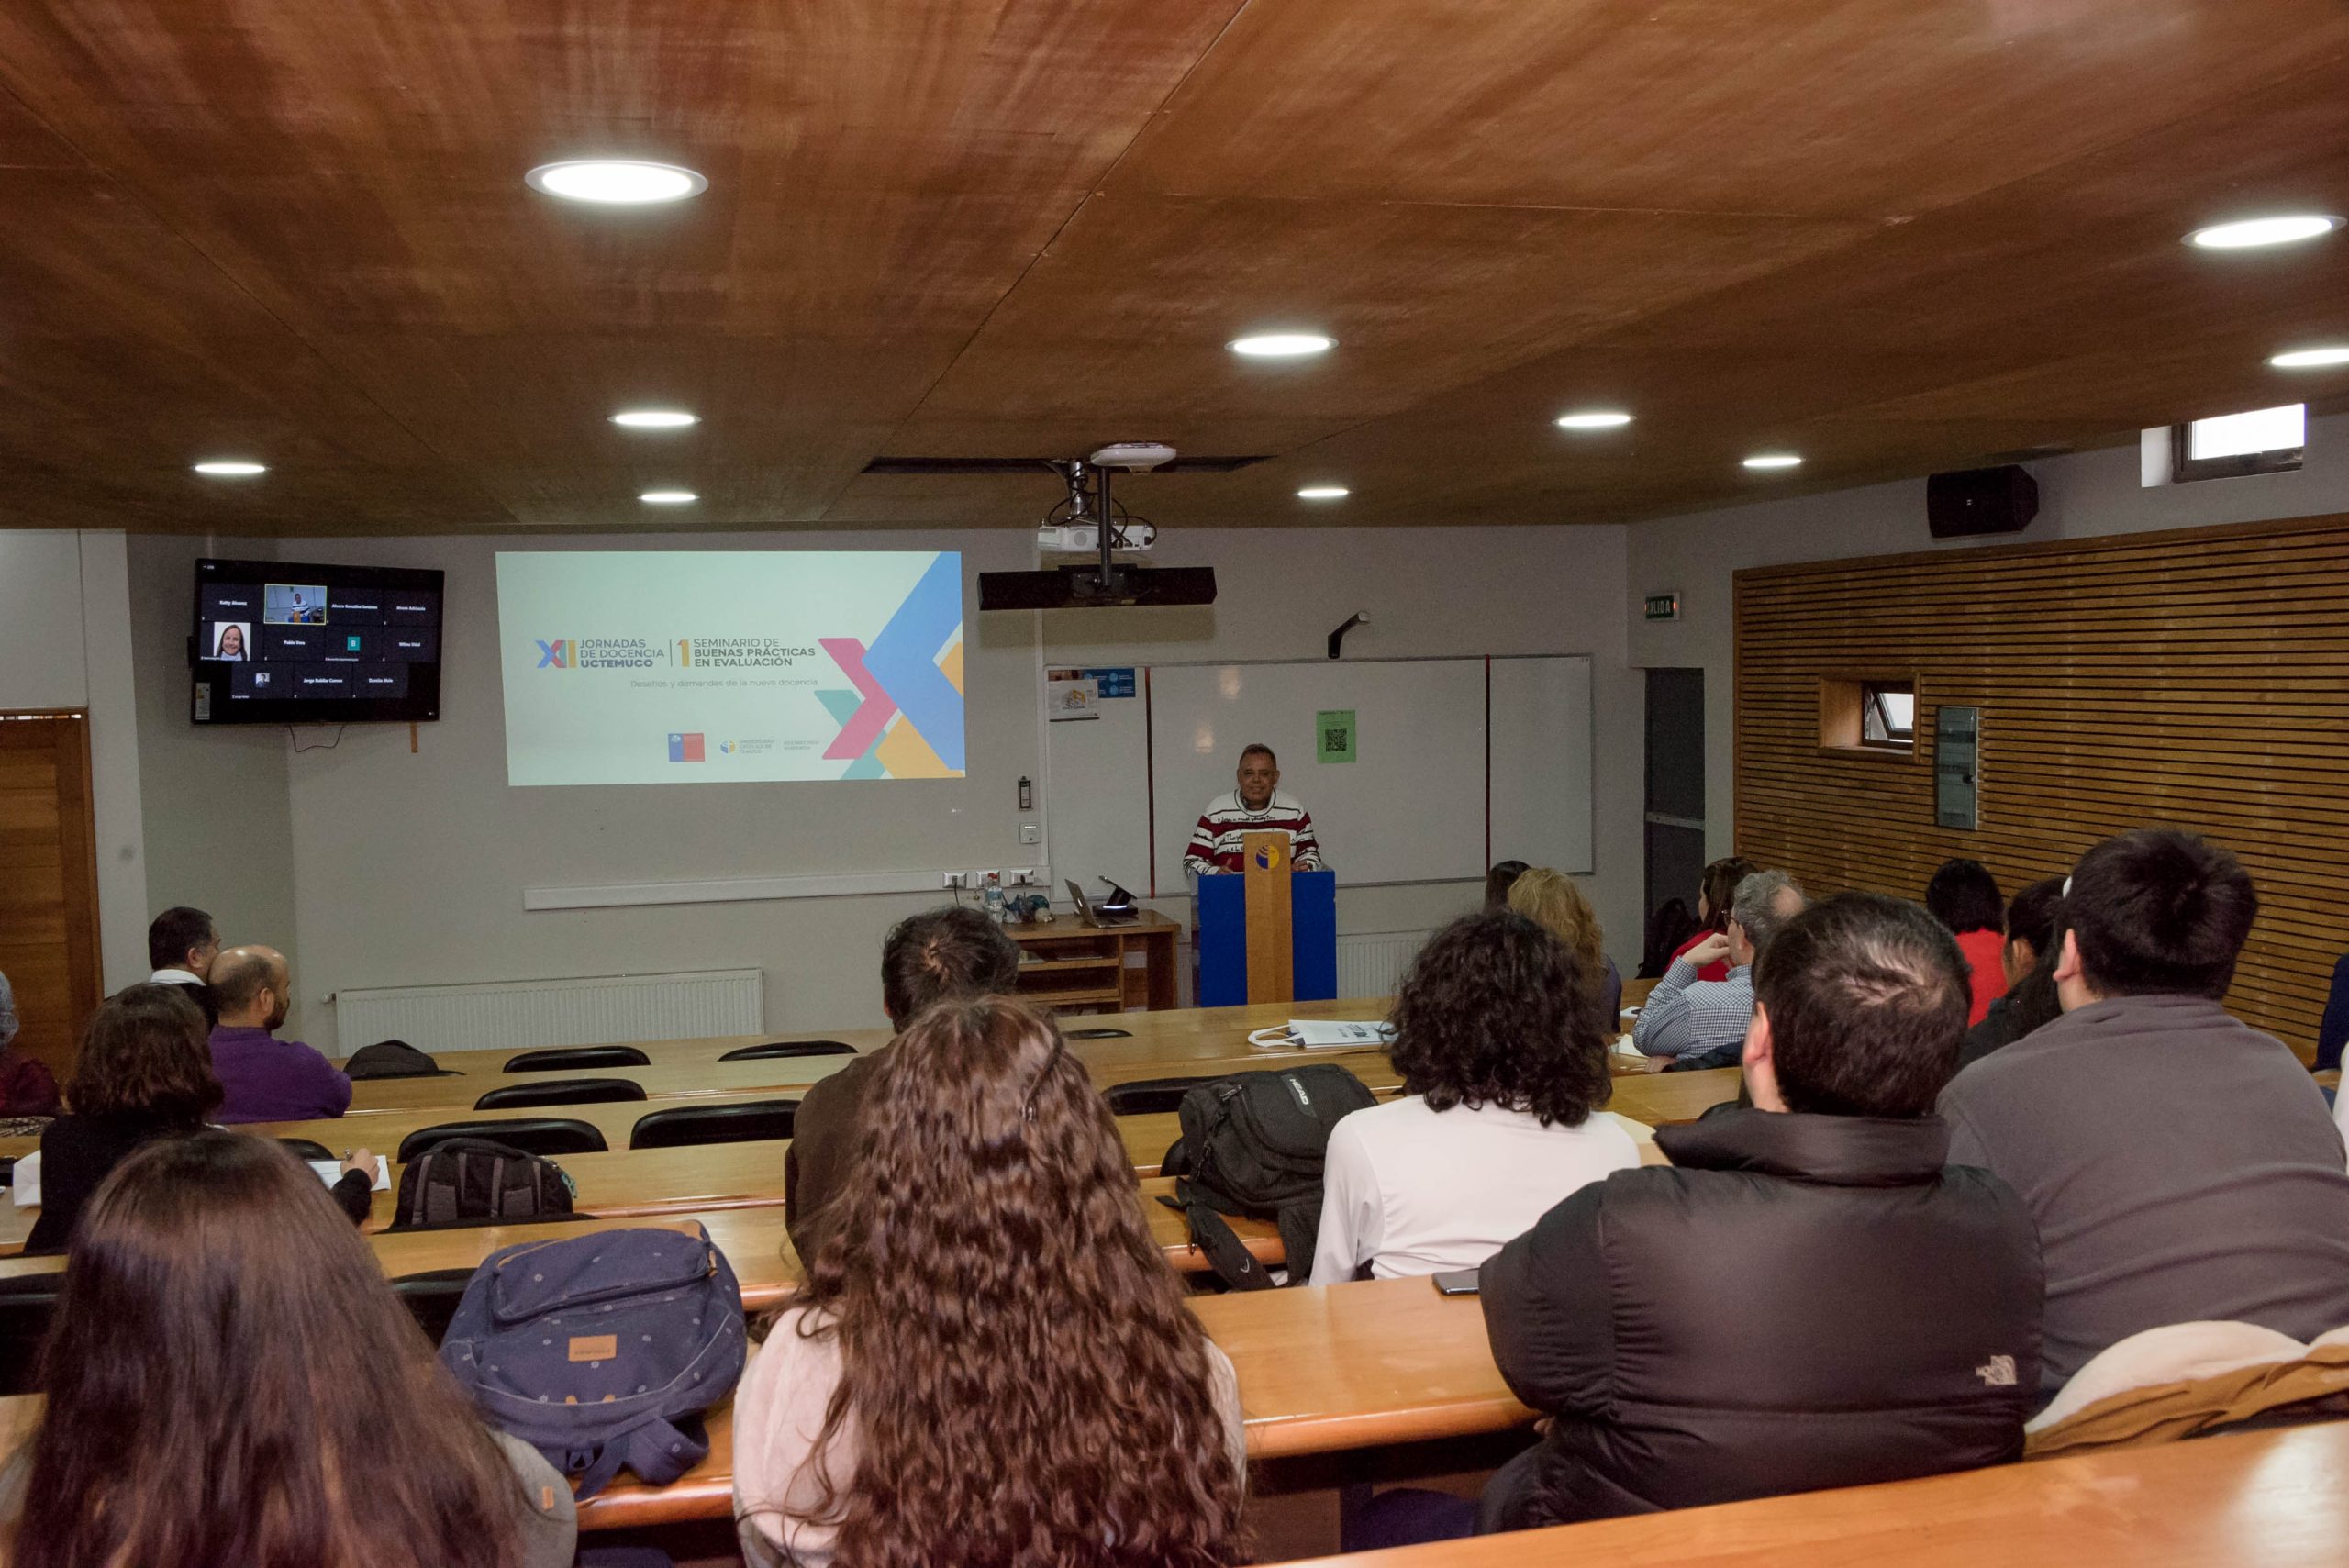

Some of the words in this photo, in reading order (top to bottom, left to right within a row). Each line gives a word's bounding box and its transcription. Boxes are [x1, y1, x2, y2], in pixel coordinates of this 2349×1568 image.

[580, 639, 646, 649] JORNADAS
[694, 639, 761, 648] SEMINARIO
[763, 638, 779, 647] DE
[580, 649, 597, 659] DE
[600, 649, 664, 659] DOCENCIA
[677, 639, 690, 668] 1
[694, 648, 743, 658] BUENAS
[747, 646, 816, 657] PRÁCTICAS
[580, 659, 653, 669] UCTEMUCO
[695, 658, 710, 668] EN
[714, 656, 793, 667] EVALUACIÓN
[670, 681, 675, 689] y
[677, 679, 723, 687] demandas
[725, 679, 738, 687] de
[1289, 1078, 1309, 1105] HEAD
